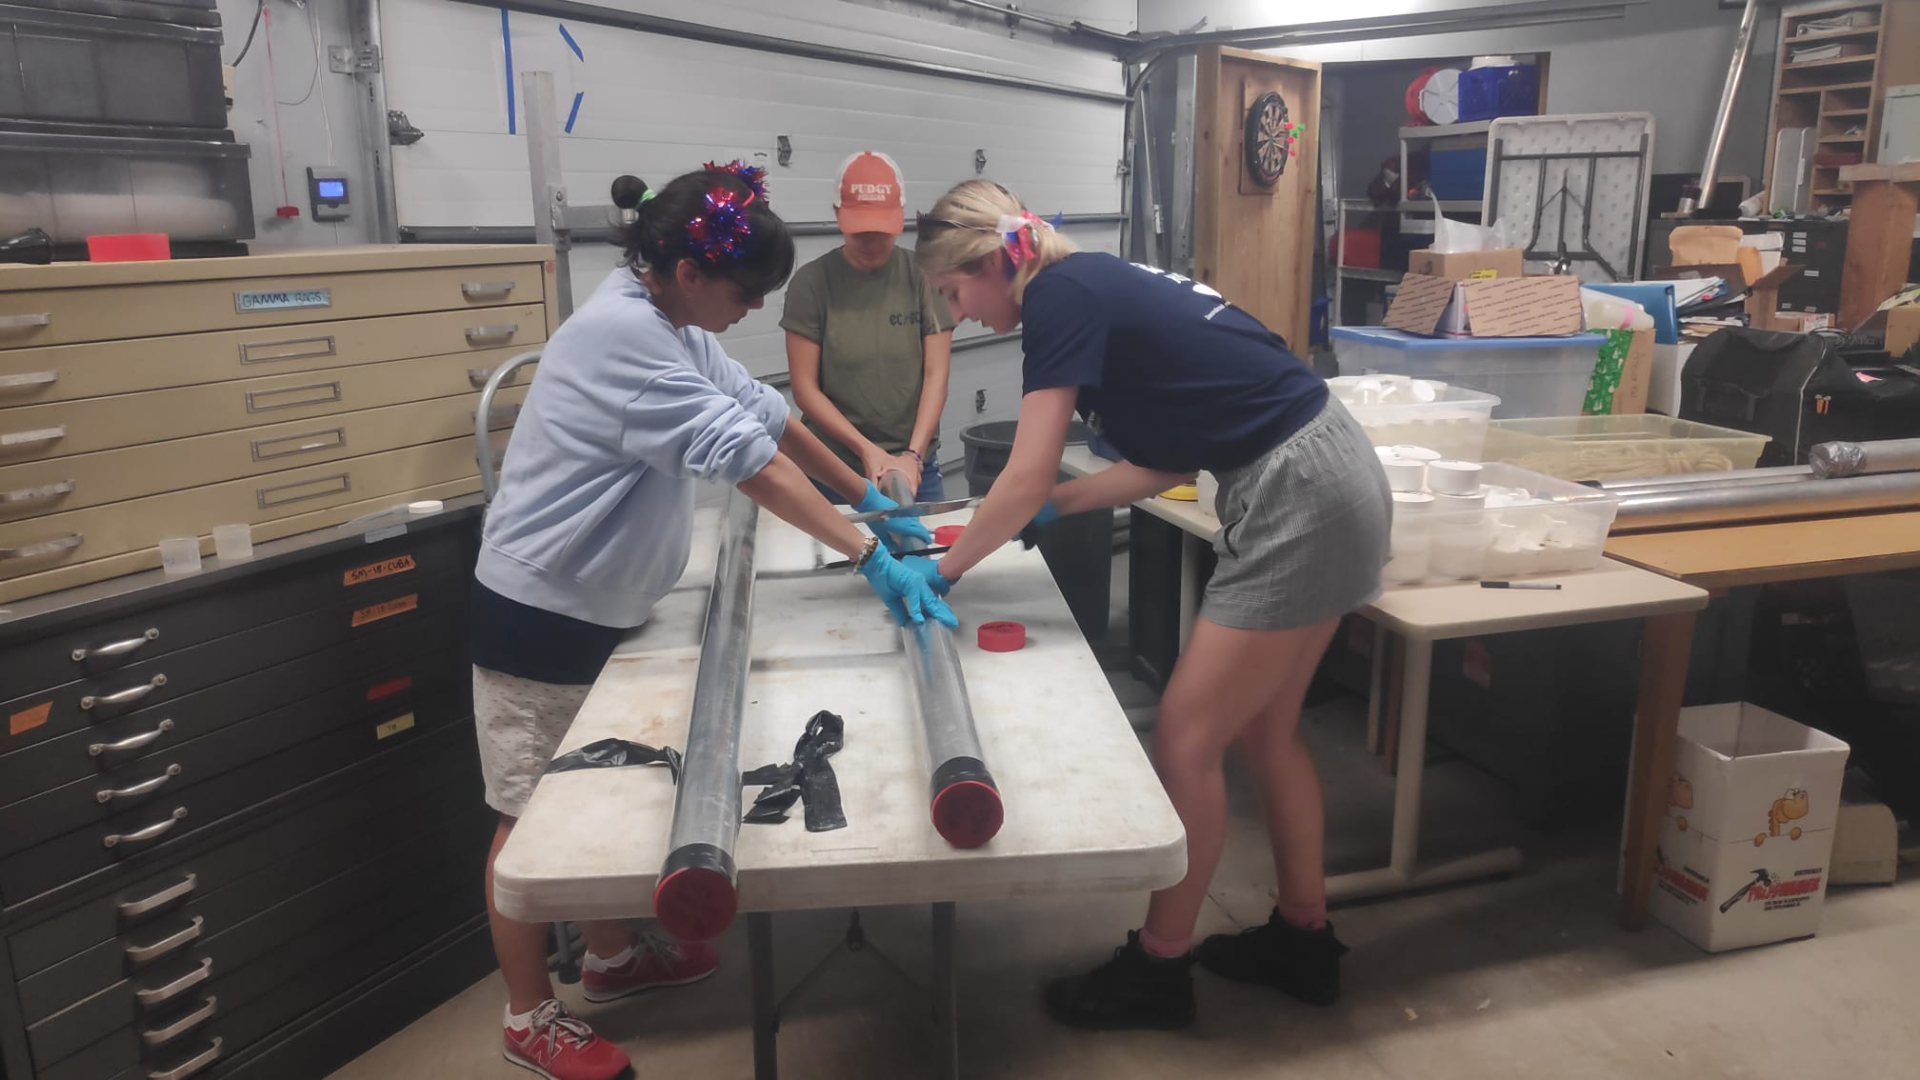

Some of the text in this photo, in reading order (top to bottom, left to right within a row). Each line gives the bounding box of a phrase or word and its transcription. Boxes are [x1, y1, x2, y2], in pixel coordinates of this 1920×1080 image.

[850, 183, 892, 194] PUDGY
[242, 291, 322, 307] GAMMA BAGS
